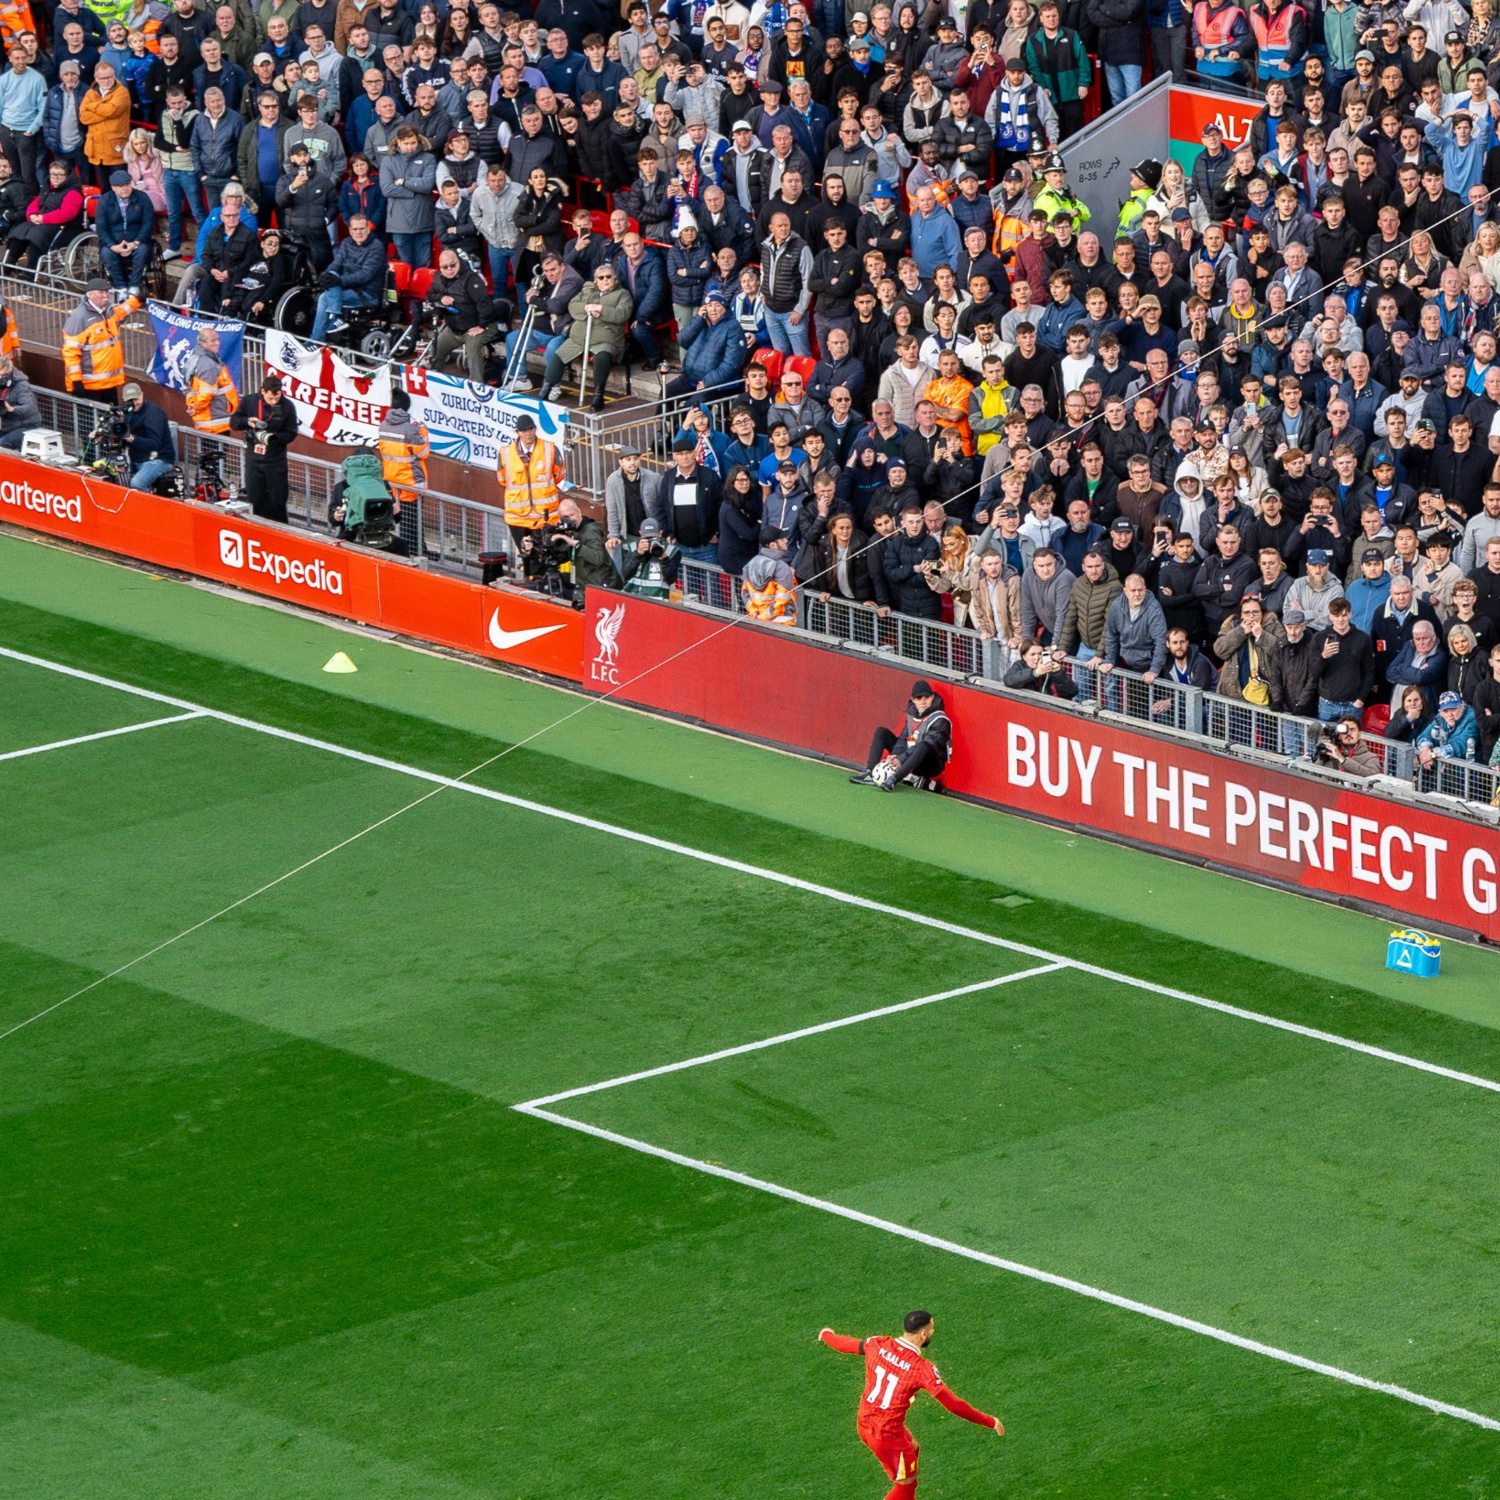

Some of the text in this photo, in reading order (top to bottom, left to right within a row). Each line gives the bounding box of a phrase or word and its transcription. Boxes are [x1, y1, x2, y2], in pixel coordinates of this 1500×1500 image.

[1079, 159, 1102, 171] ROWS
[1079, 171, 1098, 183] 8-35
[148, 303, 168, 320] COME
[165, 315, 193, 329] ALONG
[215, 323, 244, 332] ALONG
[0, 480, 82, 523] artered
[247, 539, 344, 596] Expedia
[1007, 721, 1103, 806] BUY
[1112, 750, 1211, 838] THE
[1225, 781, 1448, 900] PERFECT
[866, 1364, 900, 1410] 11
